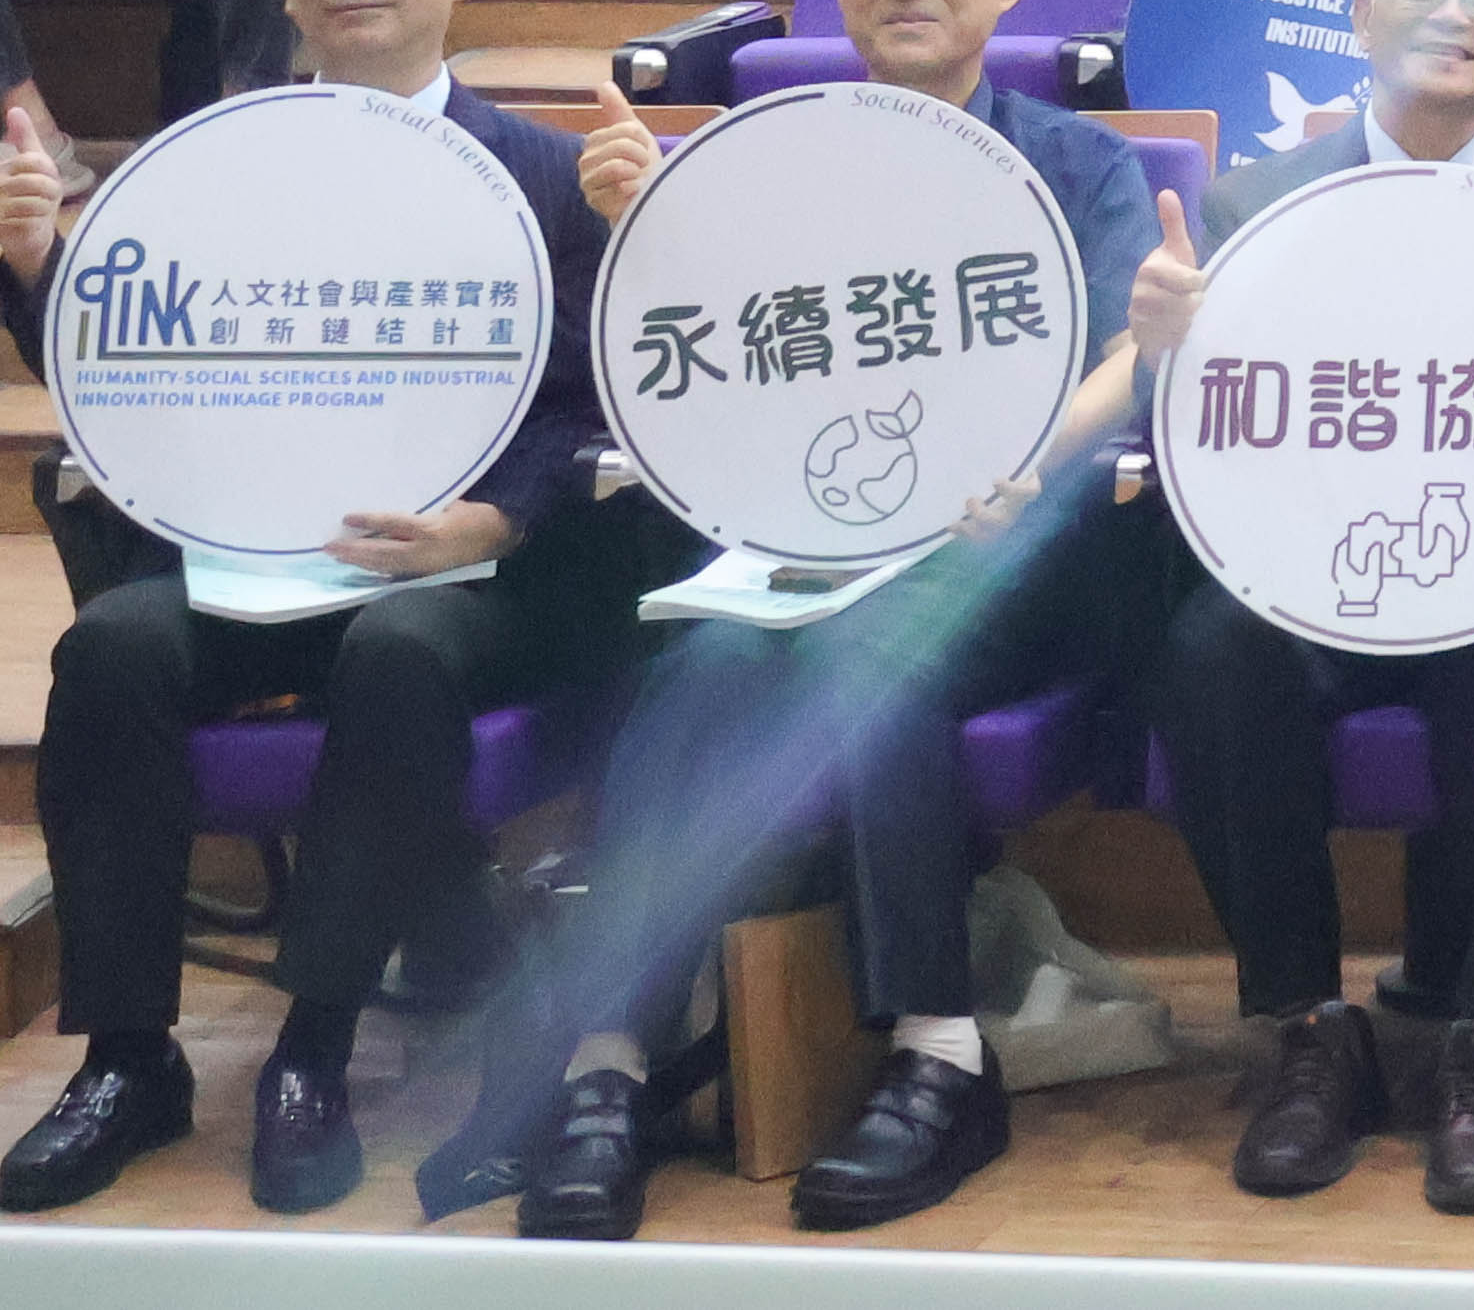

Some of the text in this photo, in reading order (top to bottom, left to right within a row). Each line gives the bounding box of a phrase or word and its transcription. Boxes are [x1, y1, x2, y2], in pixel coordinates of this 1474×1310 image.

[1265, 17, 1369, 60] INSTITUTIO
[359, 94, 514, 203] Social Sciences
[848, 87, 1017, 175] Social Sciences
[210, 278, 519, 308] 人文社會與產業實務
[209, 317, 516, 346] 創新鏈結計畫
[633, 251, 1050, 401] 永續發展
[258, 370, 352, 386] SCIENCES
[356, 371, 397, 385] AND
[402, 371, 516, 386] INDUSTRIAL
[74, 392, 385, 408] INNOVATION LINKAGE PROGRAM
